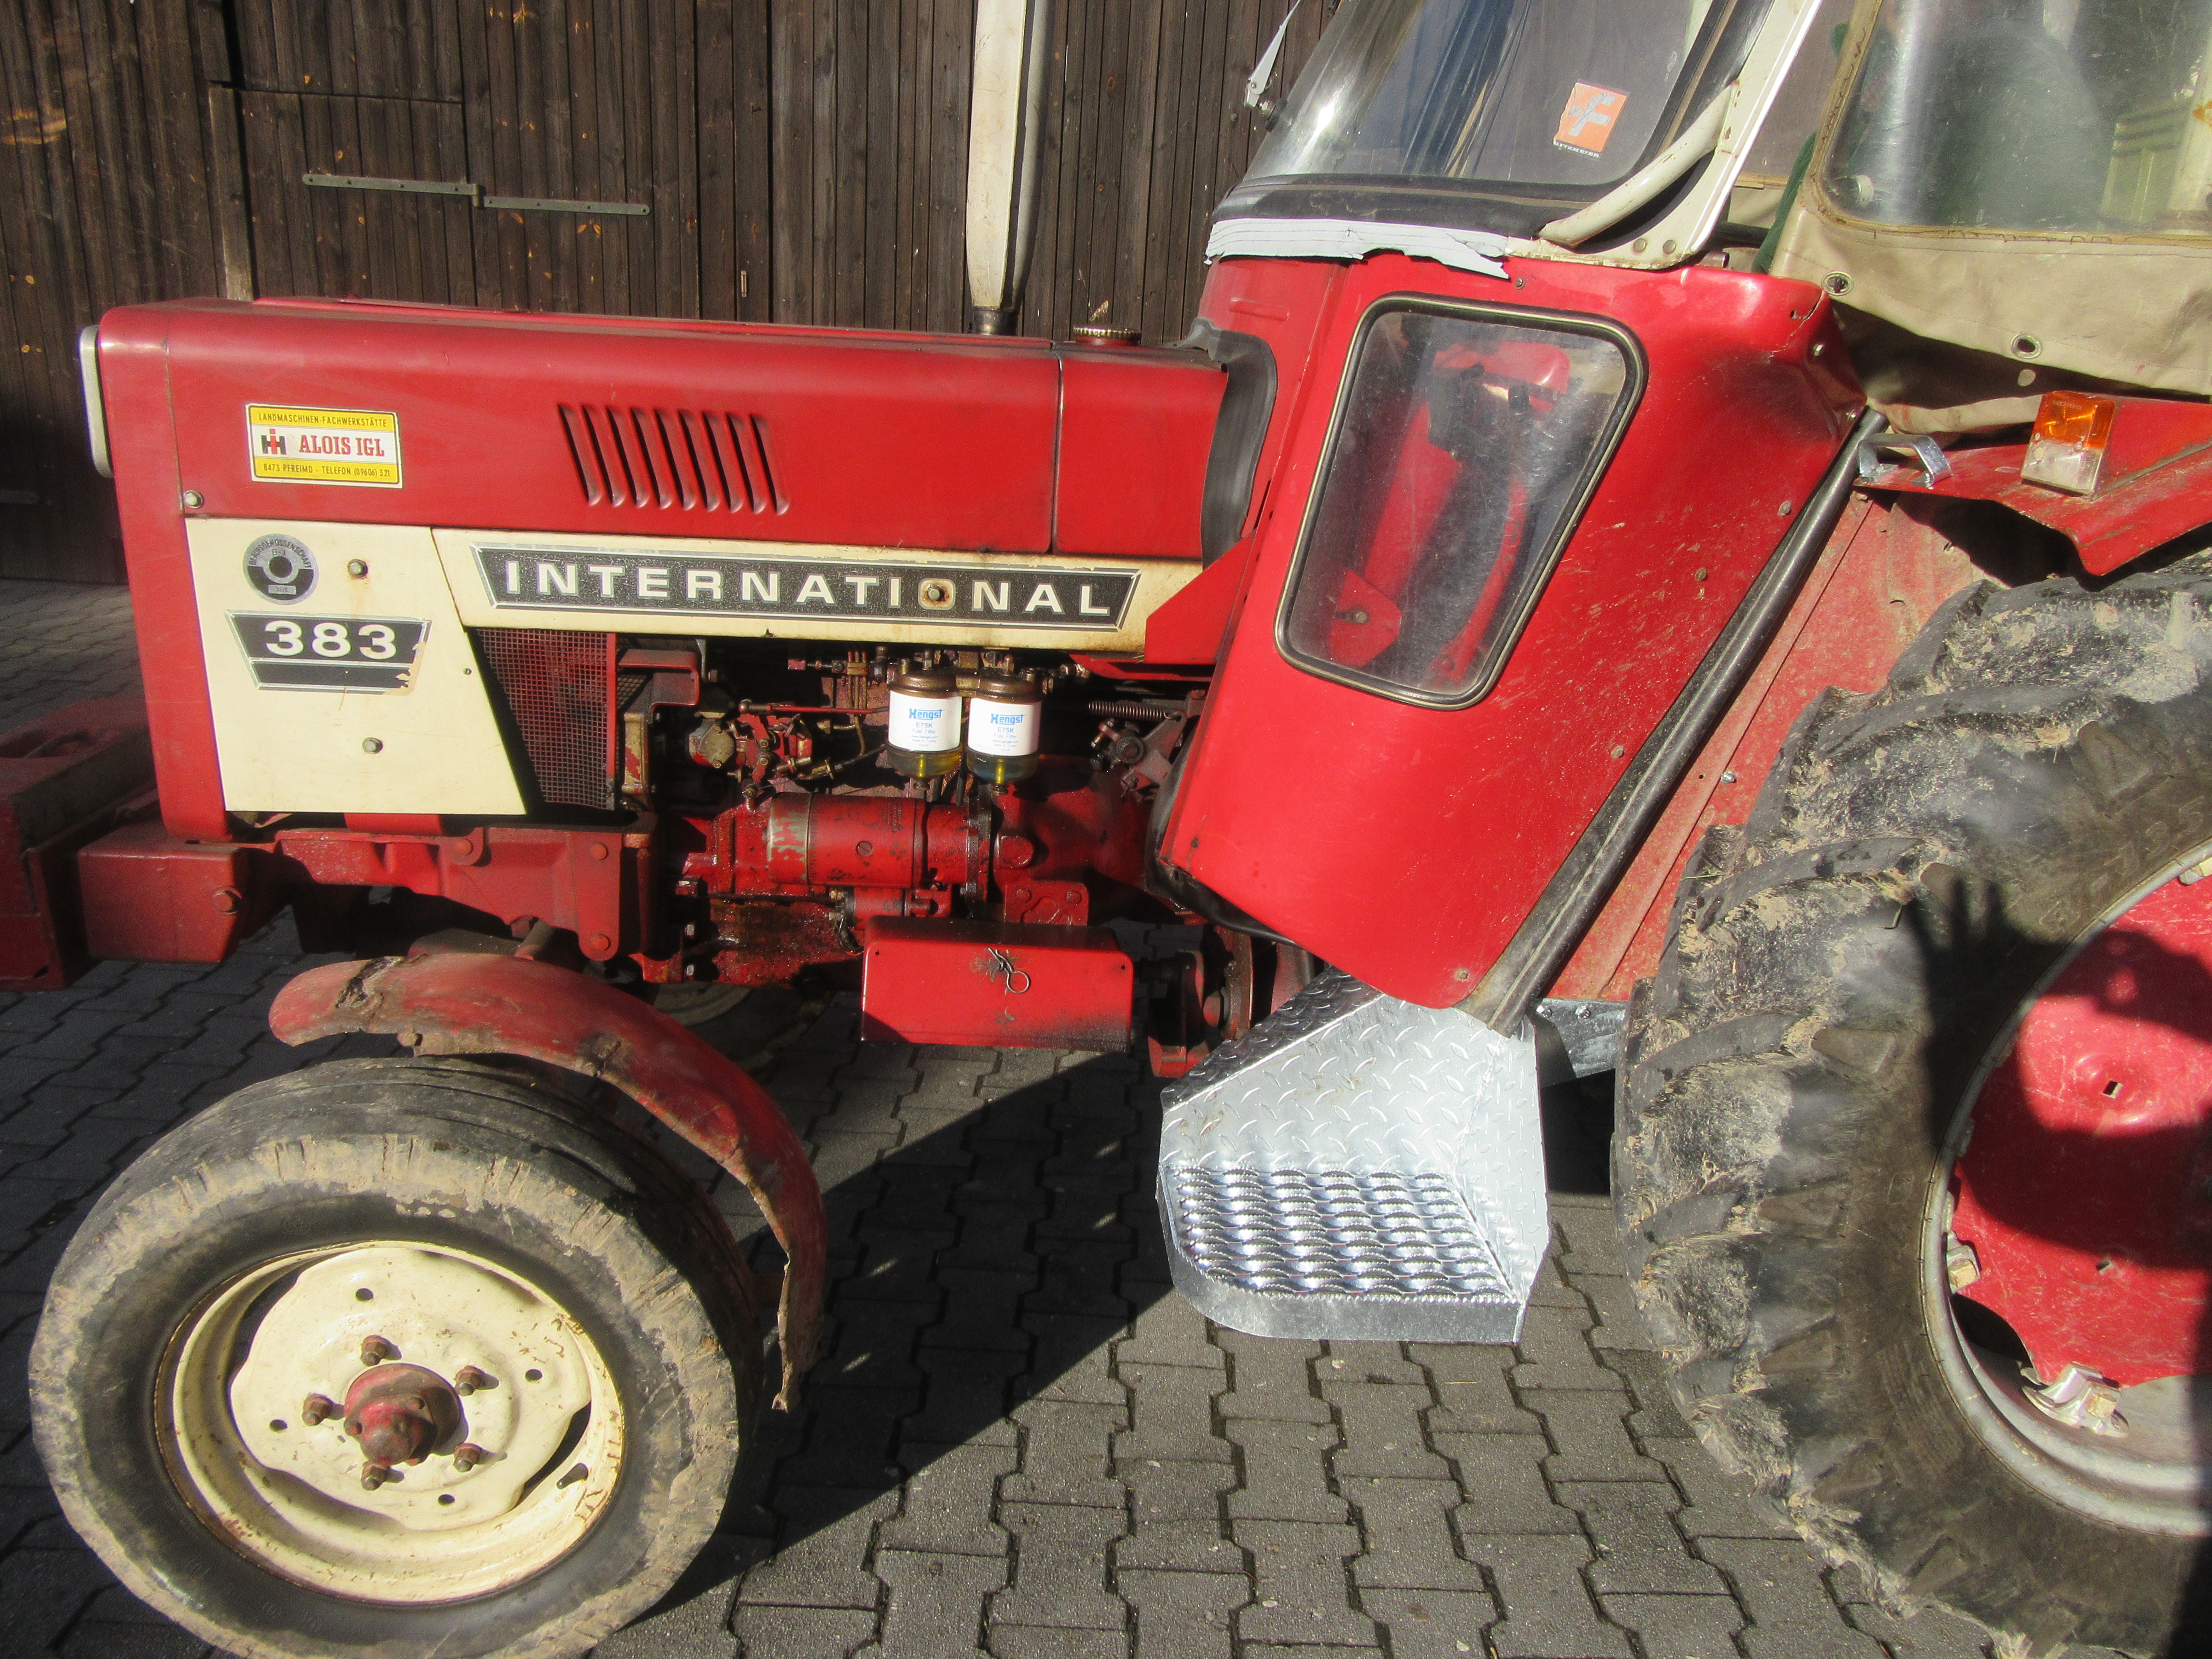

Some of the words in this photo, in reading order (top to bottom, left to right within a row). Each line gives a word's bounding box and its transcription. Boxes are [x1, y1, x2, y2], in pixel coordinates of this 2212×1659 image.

[258, 413, 387, 427] LANDMASCHINEN-FACHWERKSTÄTTE
[299, 434, 351, 455] ALOIS
[355, 437, 385, 457] IGL
[263, 463, 280, 472] 8473
[282, 464, 313, 473] PFREIMD
[321, 466, 351, 475] TELEFON
[354, 467, 377, 477] (09606)
[248, 538, 312, 569] BERUFSGENOSSENSCHAFT
[504, 560, 1111, 617] INTERNATIONAL
[264, 620, 397, 660] 383
[908, 708, 943, 720] Hengst
[990, 713, 1025, 725] Hengst
